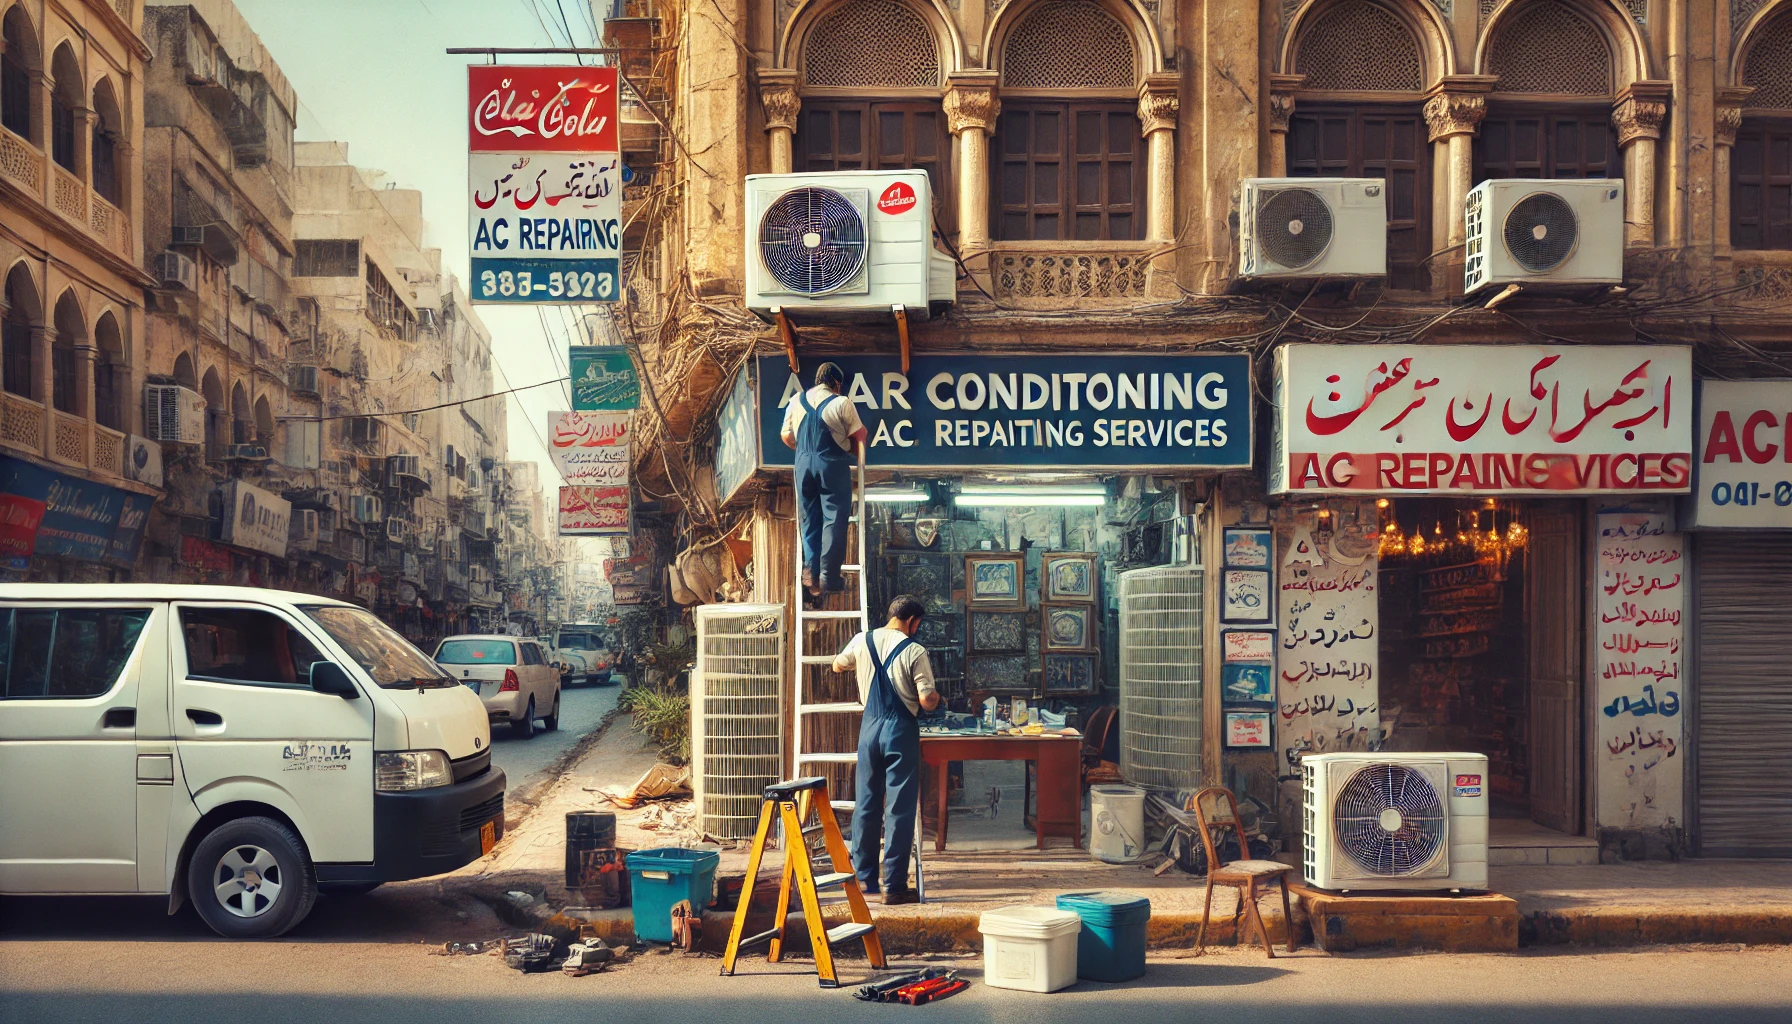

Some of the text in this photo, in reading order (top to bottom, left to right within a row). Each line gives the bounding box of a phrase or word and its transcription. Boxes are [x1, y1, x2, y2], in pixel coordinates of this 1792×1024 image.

[474, 217, 509, 250] AC
[926, 372, 1228, 411] CONDITONING
[1093, 418, 1228, 448] SERVICES
